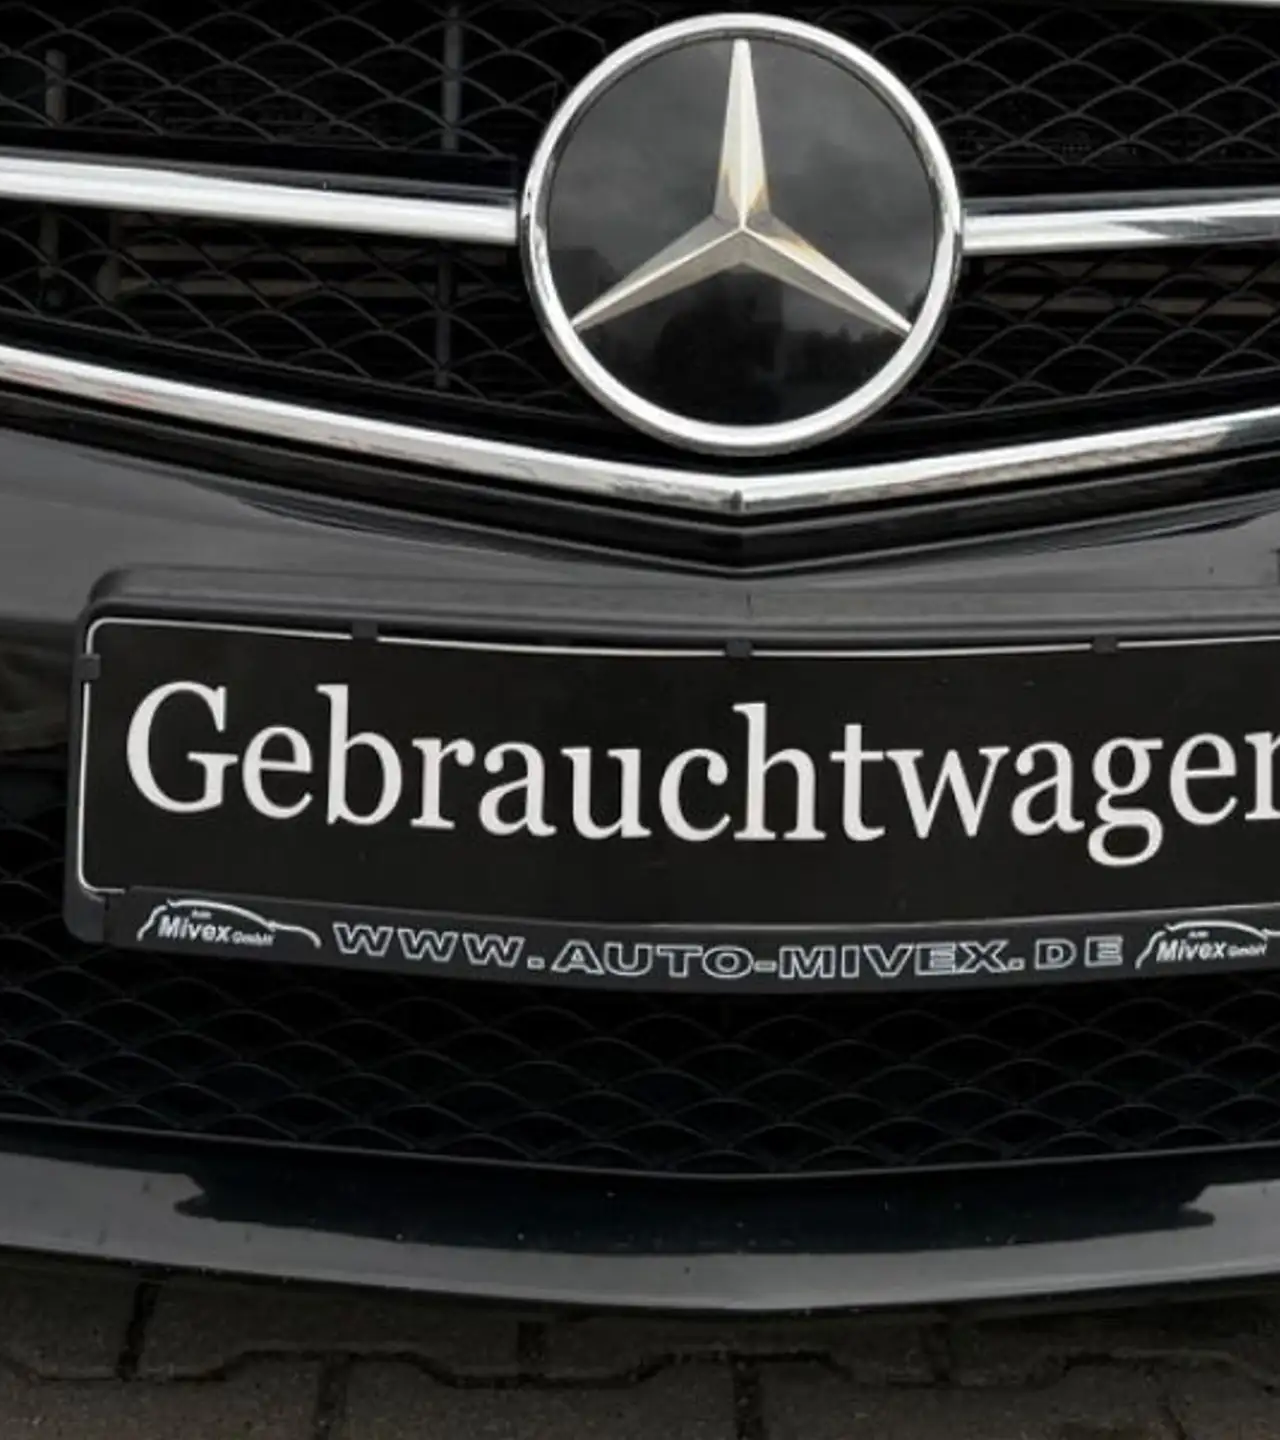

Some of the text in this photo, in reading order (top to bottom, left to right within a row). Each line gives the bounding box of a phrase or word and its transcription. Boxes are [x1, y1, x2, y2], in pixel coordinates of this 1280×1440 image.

[157, 914, 232, 944] Mivex
[333, 921, 1123, 979] WWW.AUTO-MIVEX.DE
[1156, 938, 1227, 962] Mivex
